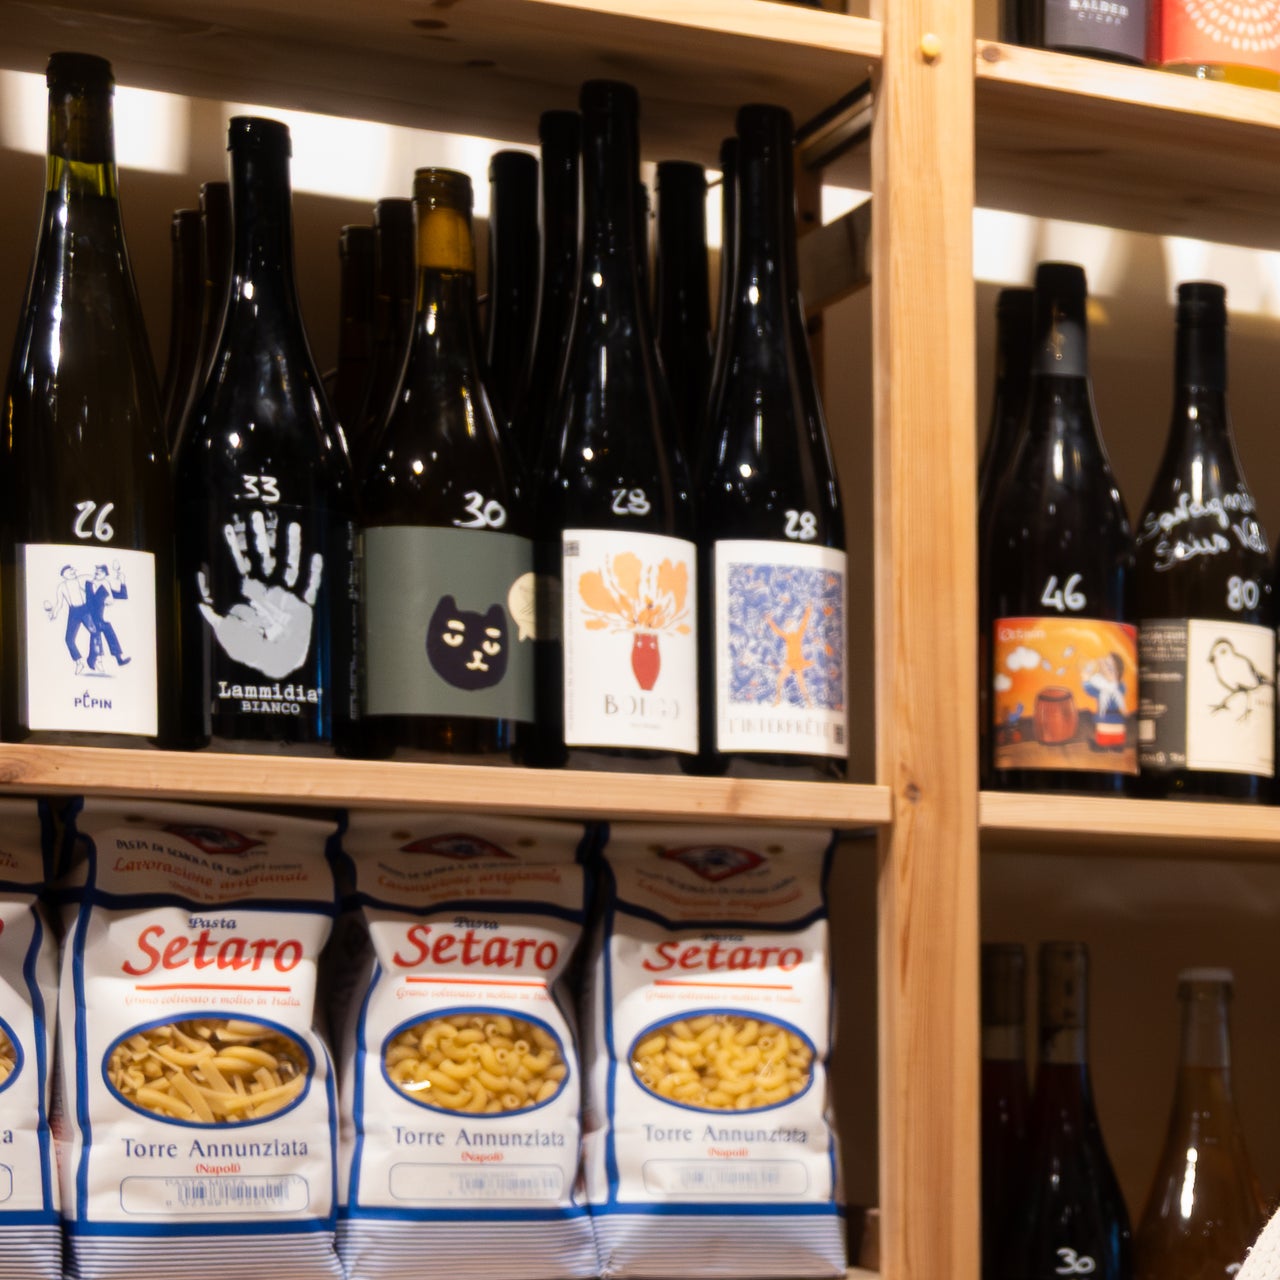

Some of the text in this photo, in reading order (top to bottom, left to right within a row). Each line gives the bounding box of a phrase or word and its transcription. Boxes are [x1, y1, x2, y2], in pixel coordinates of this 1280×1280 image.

[241, 474, 280, 503] 33
[612, 489, 651, 515] 28
[74, 501, 114, 542] 26
[453, 491, 507, 528] 30
[785, 510, 817, 540] 28
[1041, 573, 1087, 612] 46
[1227, 576, 1259, 610] 80
[218, 681, 321, 703] Lammidia
[242, 701, 300, 715] BIANCO
[188, 917, 237, 930] Pasta
[121, 924, 304, 976] Setaro
[392, 924, 559, 971] Setaro
[642, 941, 804, 972] Setaro
[392, 1126, 565, 1147] Torre Annunziata
[644, 1123, 808, 1145] Torre Annunziata
[121, 1138, 309, 1158] Torre Annunziata
[461, 1151, 504, 1162] (Napoli)
[195, 1162, 241, 1176] (Napoli)
[1055, 1247, 1096, 1274] 30
